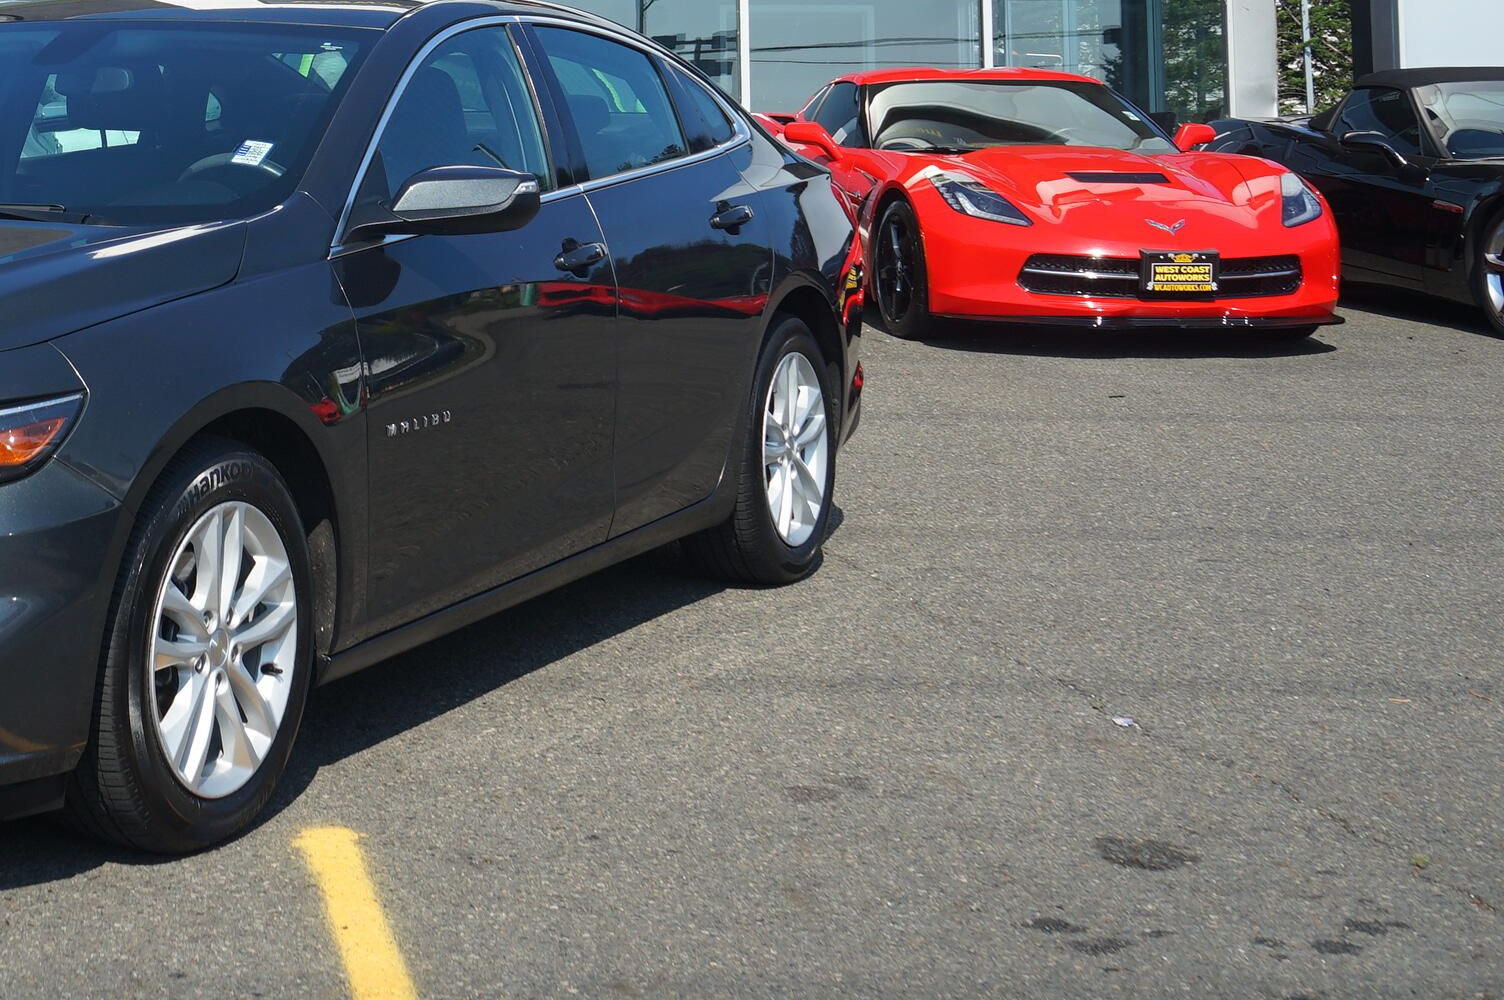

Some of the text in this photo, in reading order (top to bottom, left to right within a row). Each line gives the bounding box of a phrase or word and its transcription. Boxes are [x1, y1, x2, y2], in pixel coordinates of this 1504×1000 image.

[1181, 265, 1210, 273] COAST
[1155, 273, 1210, 281] AUTOWORKS
[386, 410, 451, 437] MALIBU
